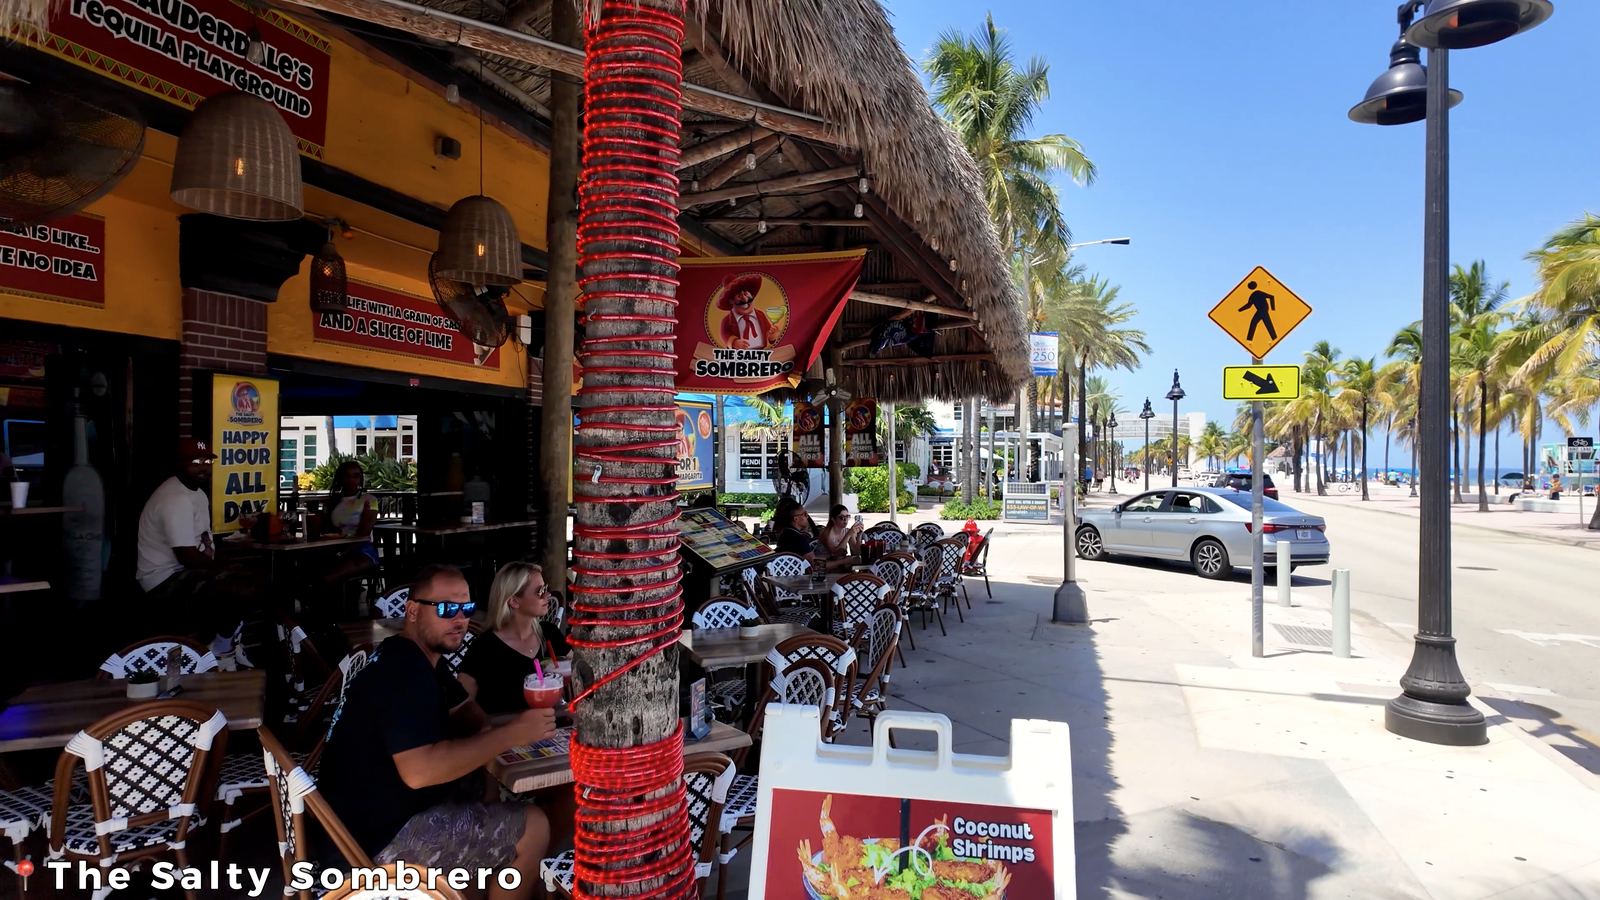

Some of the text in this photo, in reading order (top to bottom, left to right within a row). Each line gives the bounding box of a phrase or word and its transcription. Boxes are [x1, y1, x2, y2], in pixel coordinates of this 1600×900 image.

[30, 224, 50, 242] IS
[51, 227, 100, 254] LIKE...
[17, 248, 51, 272] NO
[52, 256, 98, 281] IDEA
[346, 295, 367, 312] LIFE
[368, 300, 394, 317] WITH
[394, 306, 402, 318] A
[403, 309, 431, 325] GRAIN
[432, 316, 444, 328] OF
[320, 312, 453, 351] AND A SLICE OF LIME
[713, 348, 773, 361] THE SALTY
[1033, 352, 1055, 361] 250
[695, 359, 794, 378] SOMBRERO
[222, 431, 269, 445] HAPPY
[800, 434, 820, 446] ALL
[852, 433, 872, 445] ALL
[221, 447, 271, 465] HOUR
[693, 457, 696, 470] 1
[741, 458, 760, 466] FENDI
[225, 471, 266, 495] ALL
[224, 500, 269, 524] DAY
[953, 816, 1034, 840] Coconut
[952, 838, 1035, 864] Shrimps
